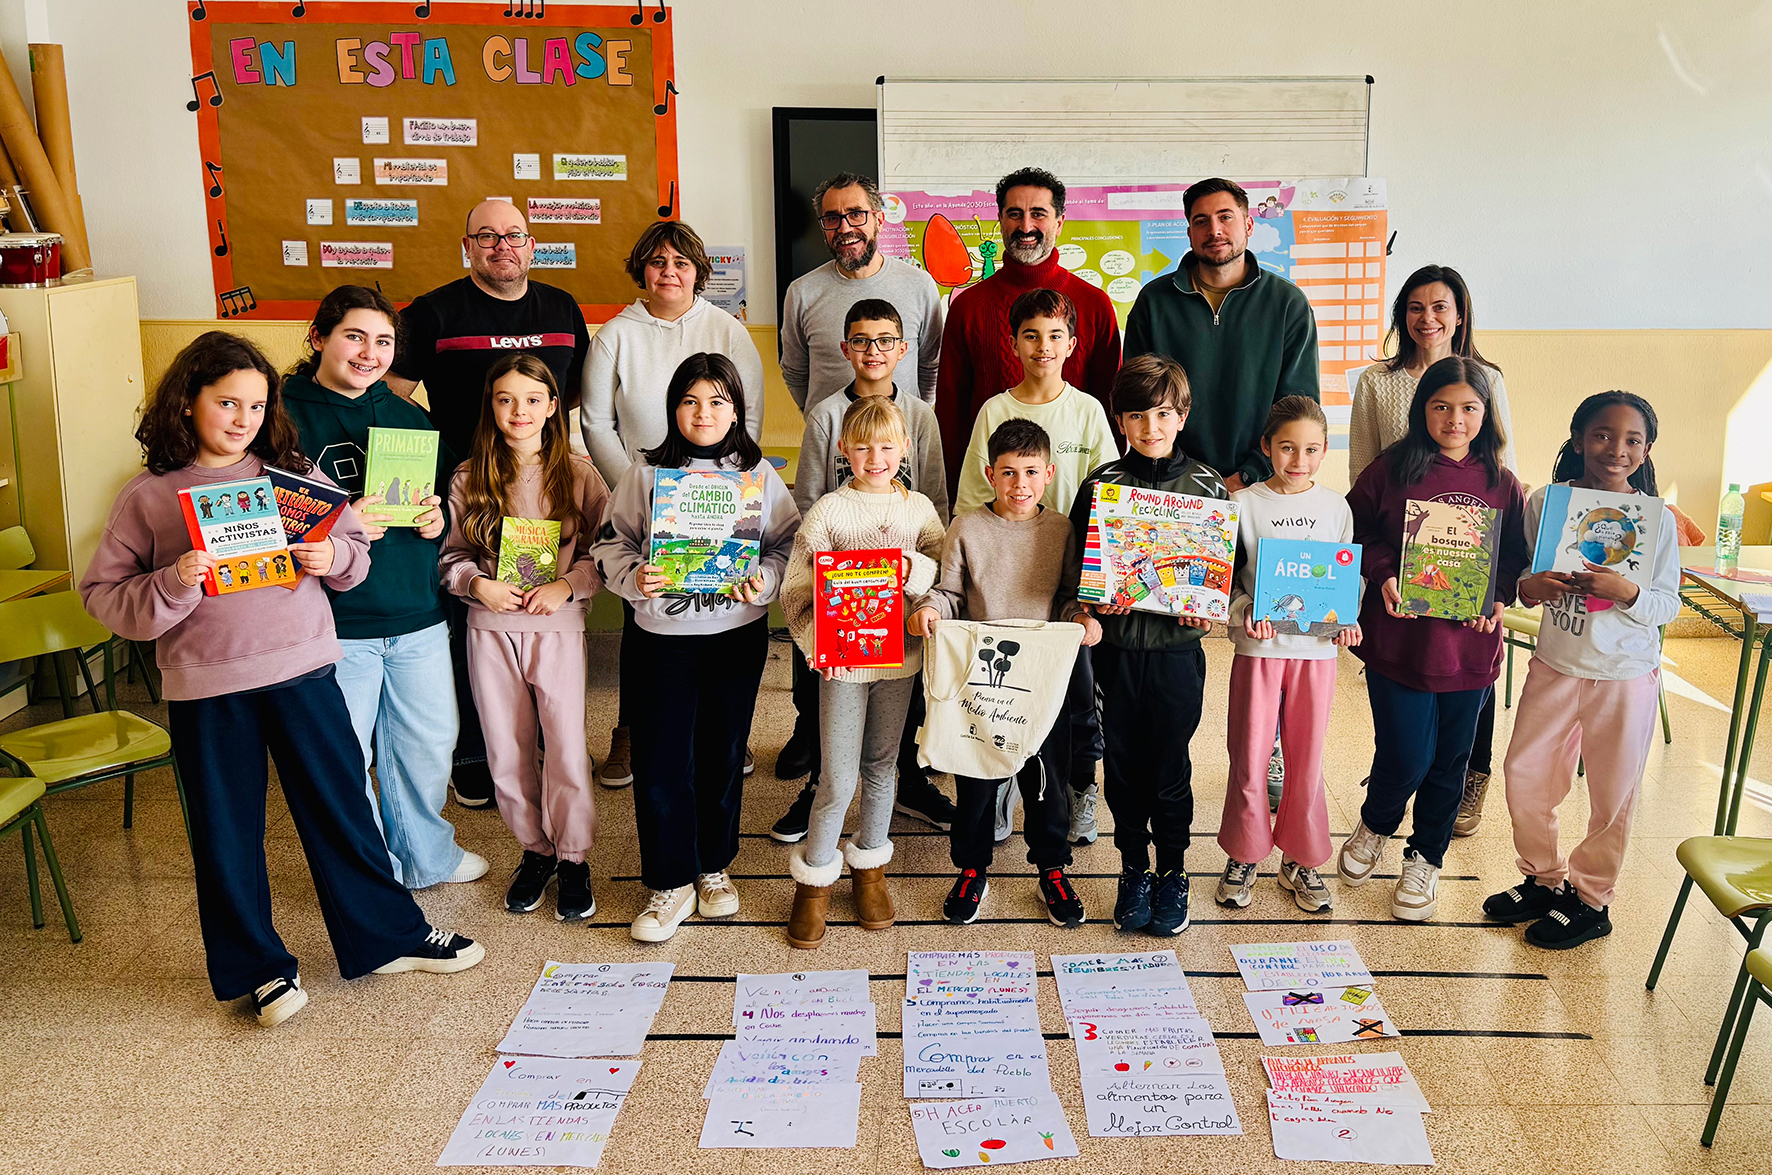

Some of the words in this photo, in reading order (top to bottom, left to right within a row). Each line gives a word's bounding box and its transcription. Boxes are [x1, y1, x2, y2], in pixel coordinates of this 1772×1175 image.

[229, 36, 297, 88] EN
[335, 31, 457, 88] ESTA
[482, 31, 634, 88] CLASE
[528, 200, 539, 209] LA
[374, 433, 434, 454] PRIMATES
[691, 490, 733, 501] CAMBIO
[679, 500, 736, 514] CLIMÁTICO
[223, 521, 260, 534] NIÑOS
[515, 523, 547, 536] MÚSICA
[1446, 526, 1457, 535] El
[210, 527, 278, 544] ACTIVISTAS
[521, 535, 550, 545] RAMAS
[1431, 535, 1471, 548] bosque
[1300, 552, 1311, 560] UN
[1423, 547, 1435, 555] es
[1436, 547, 1477, 559] nuestra
[1437, 559, 1461, 568] casa
[1549, 607, 1585, 637] YOU
[957, 698, 987, 717] Medio
[988, 708, 1029, 726] Ambiente
[1309, 944, 1338, 952] USO
[985, 951, 1034, 959] PRODUCTOS
[1239, 956, 1301, 964] DURANTE
[1061, 958, 1106, 968] COMER
[983, 970, 1031, 979] LOCALES
[919, 998, 975, 1009] Compramos
[742, 1010, 754, 1019] 4
[760, 1007, 786, 1020] Nos
[934, 1008, 943, 1016] el
[945, 1008, 998, 1018] supermercado
[918, 1042, 994, 1069] Comprar
[767, 1061, 787, 1071] los
[966, 1065, 985, 1074] del
[508, 1067, 561, 1081] Comprar
[575, 1076, 592, 1084] en
[1106, 1079, 1182, 1091] Alternar
[476, 1099, 532, 1110] COMPRAR
[563, 1101, 618, 1111] PRODUCTOS
[1096, 1091, 1178, 1102] alimentos
[1184, 1092, 1225, 1107] para
[926, 1103, 982, 1121] HACER
[994, 1096, 1038, 1108] HUERTO
[1142, 1104, 1168, 1113] un
[1375, 1106, 1395, 1115] No
[467, 1113, 493, 1126] EN
[495, 1114, 524, 1125] LAS
[528, 1115, 590, 1126] TIENDAS
[1103, 1112, 1163, 1137] Mejor
[473, 1129, 524, 1140] LOCALES
[534, 1131, 557, 1142] EN
[1337, 1129, 1353, 1139] 2
